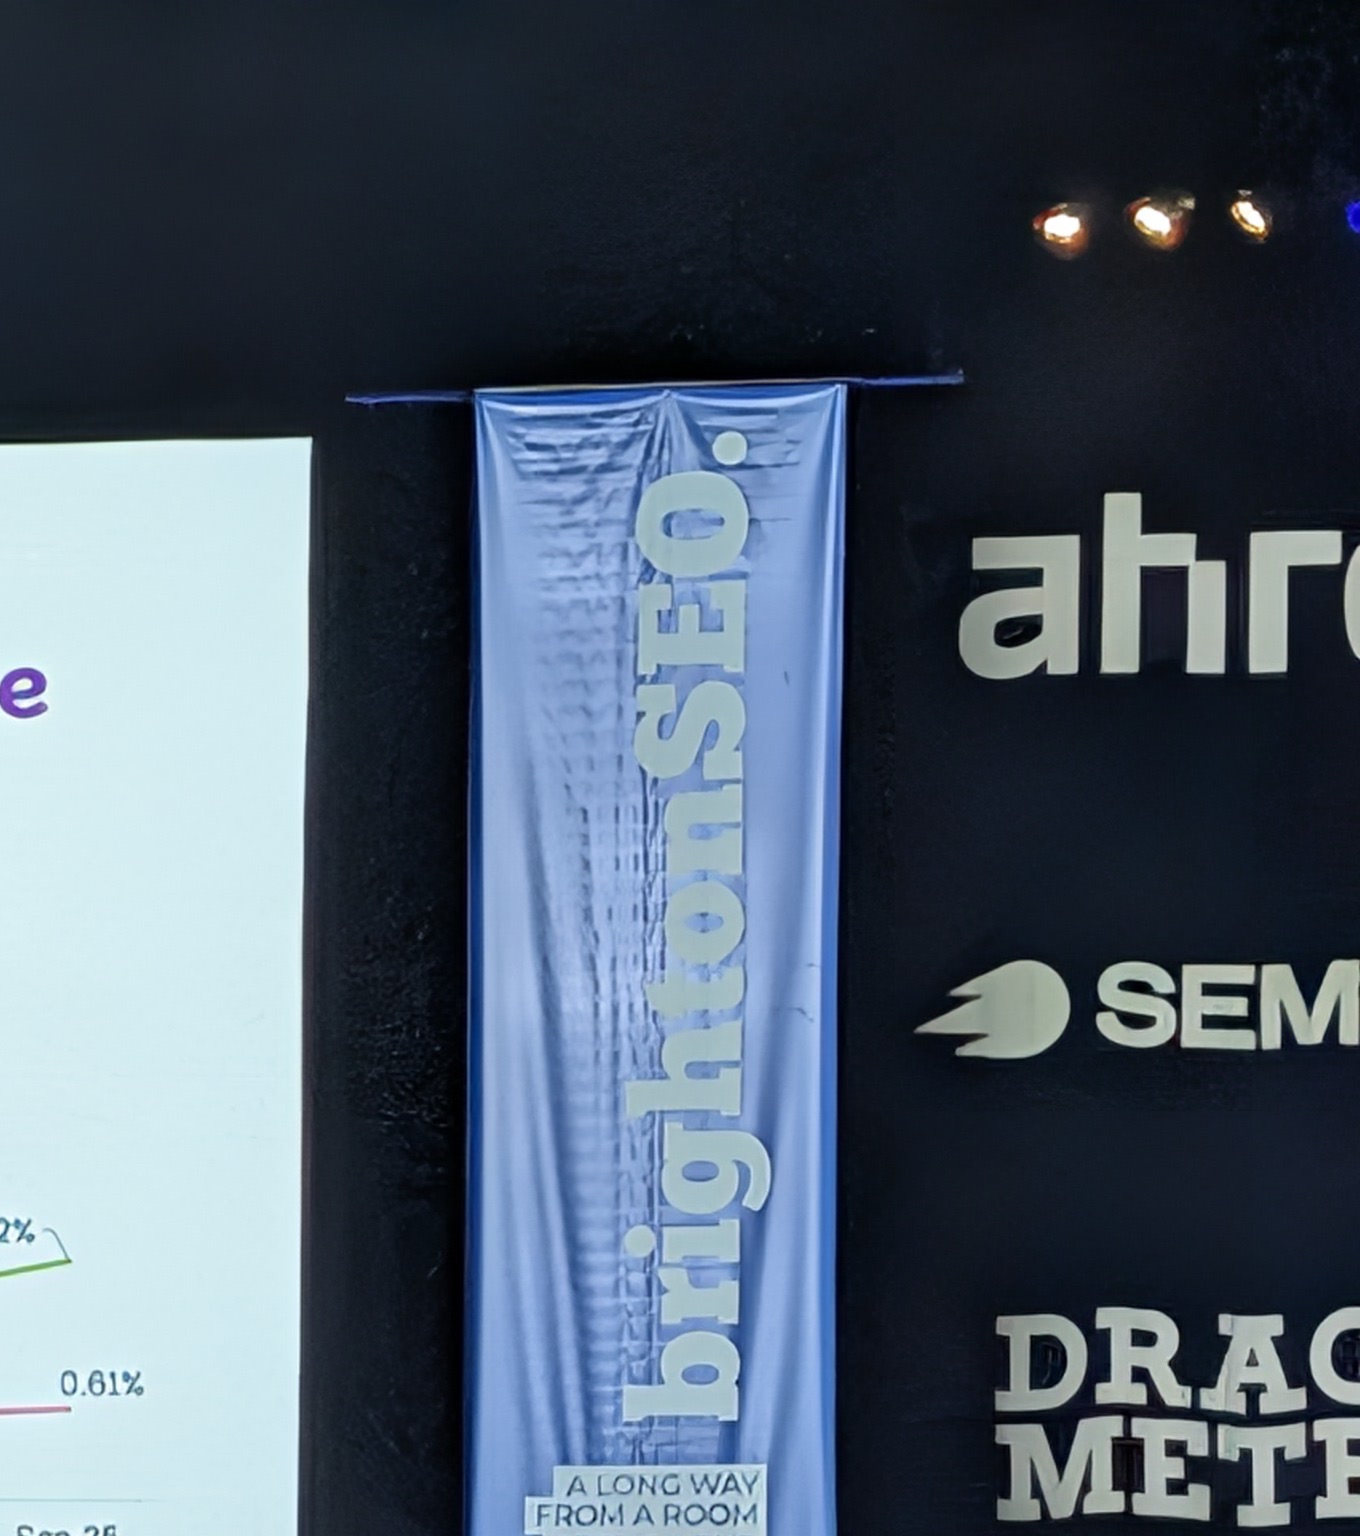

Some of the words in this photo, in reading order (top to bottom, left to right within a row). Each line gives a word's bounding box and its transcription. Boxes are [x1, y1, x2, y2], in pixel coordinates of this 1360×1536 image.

[959, 493, 1360, 679] ahr
[622, 431, 772, 1423] brightonSEO.
[536, 1503, 625, 1527] FROM
[633, 1504, 655, 1527] A
[664, 1503, 758, 1527] ROOM
[567, 1474, 587, 1496] A
[596, 1473, 681, 1496] LONG
[689, 1472, 759, 1496] WAY
